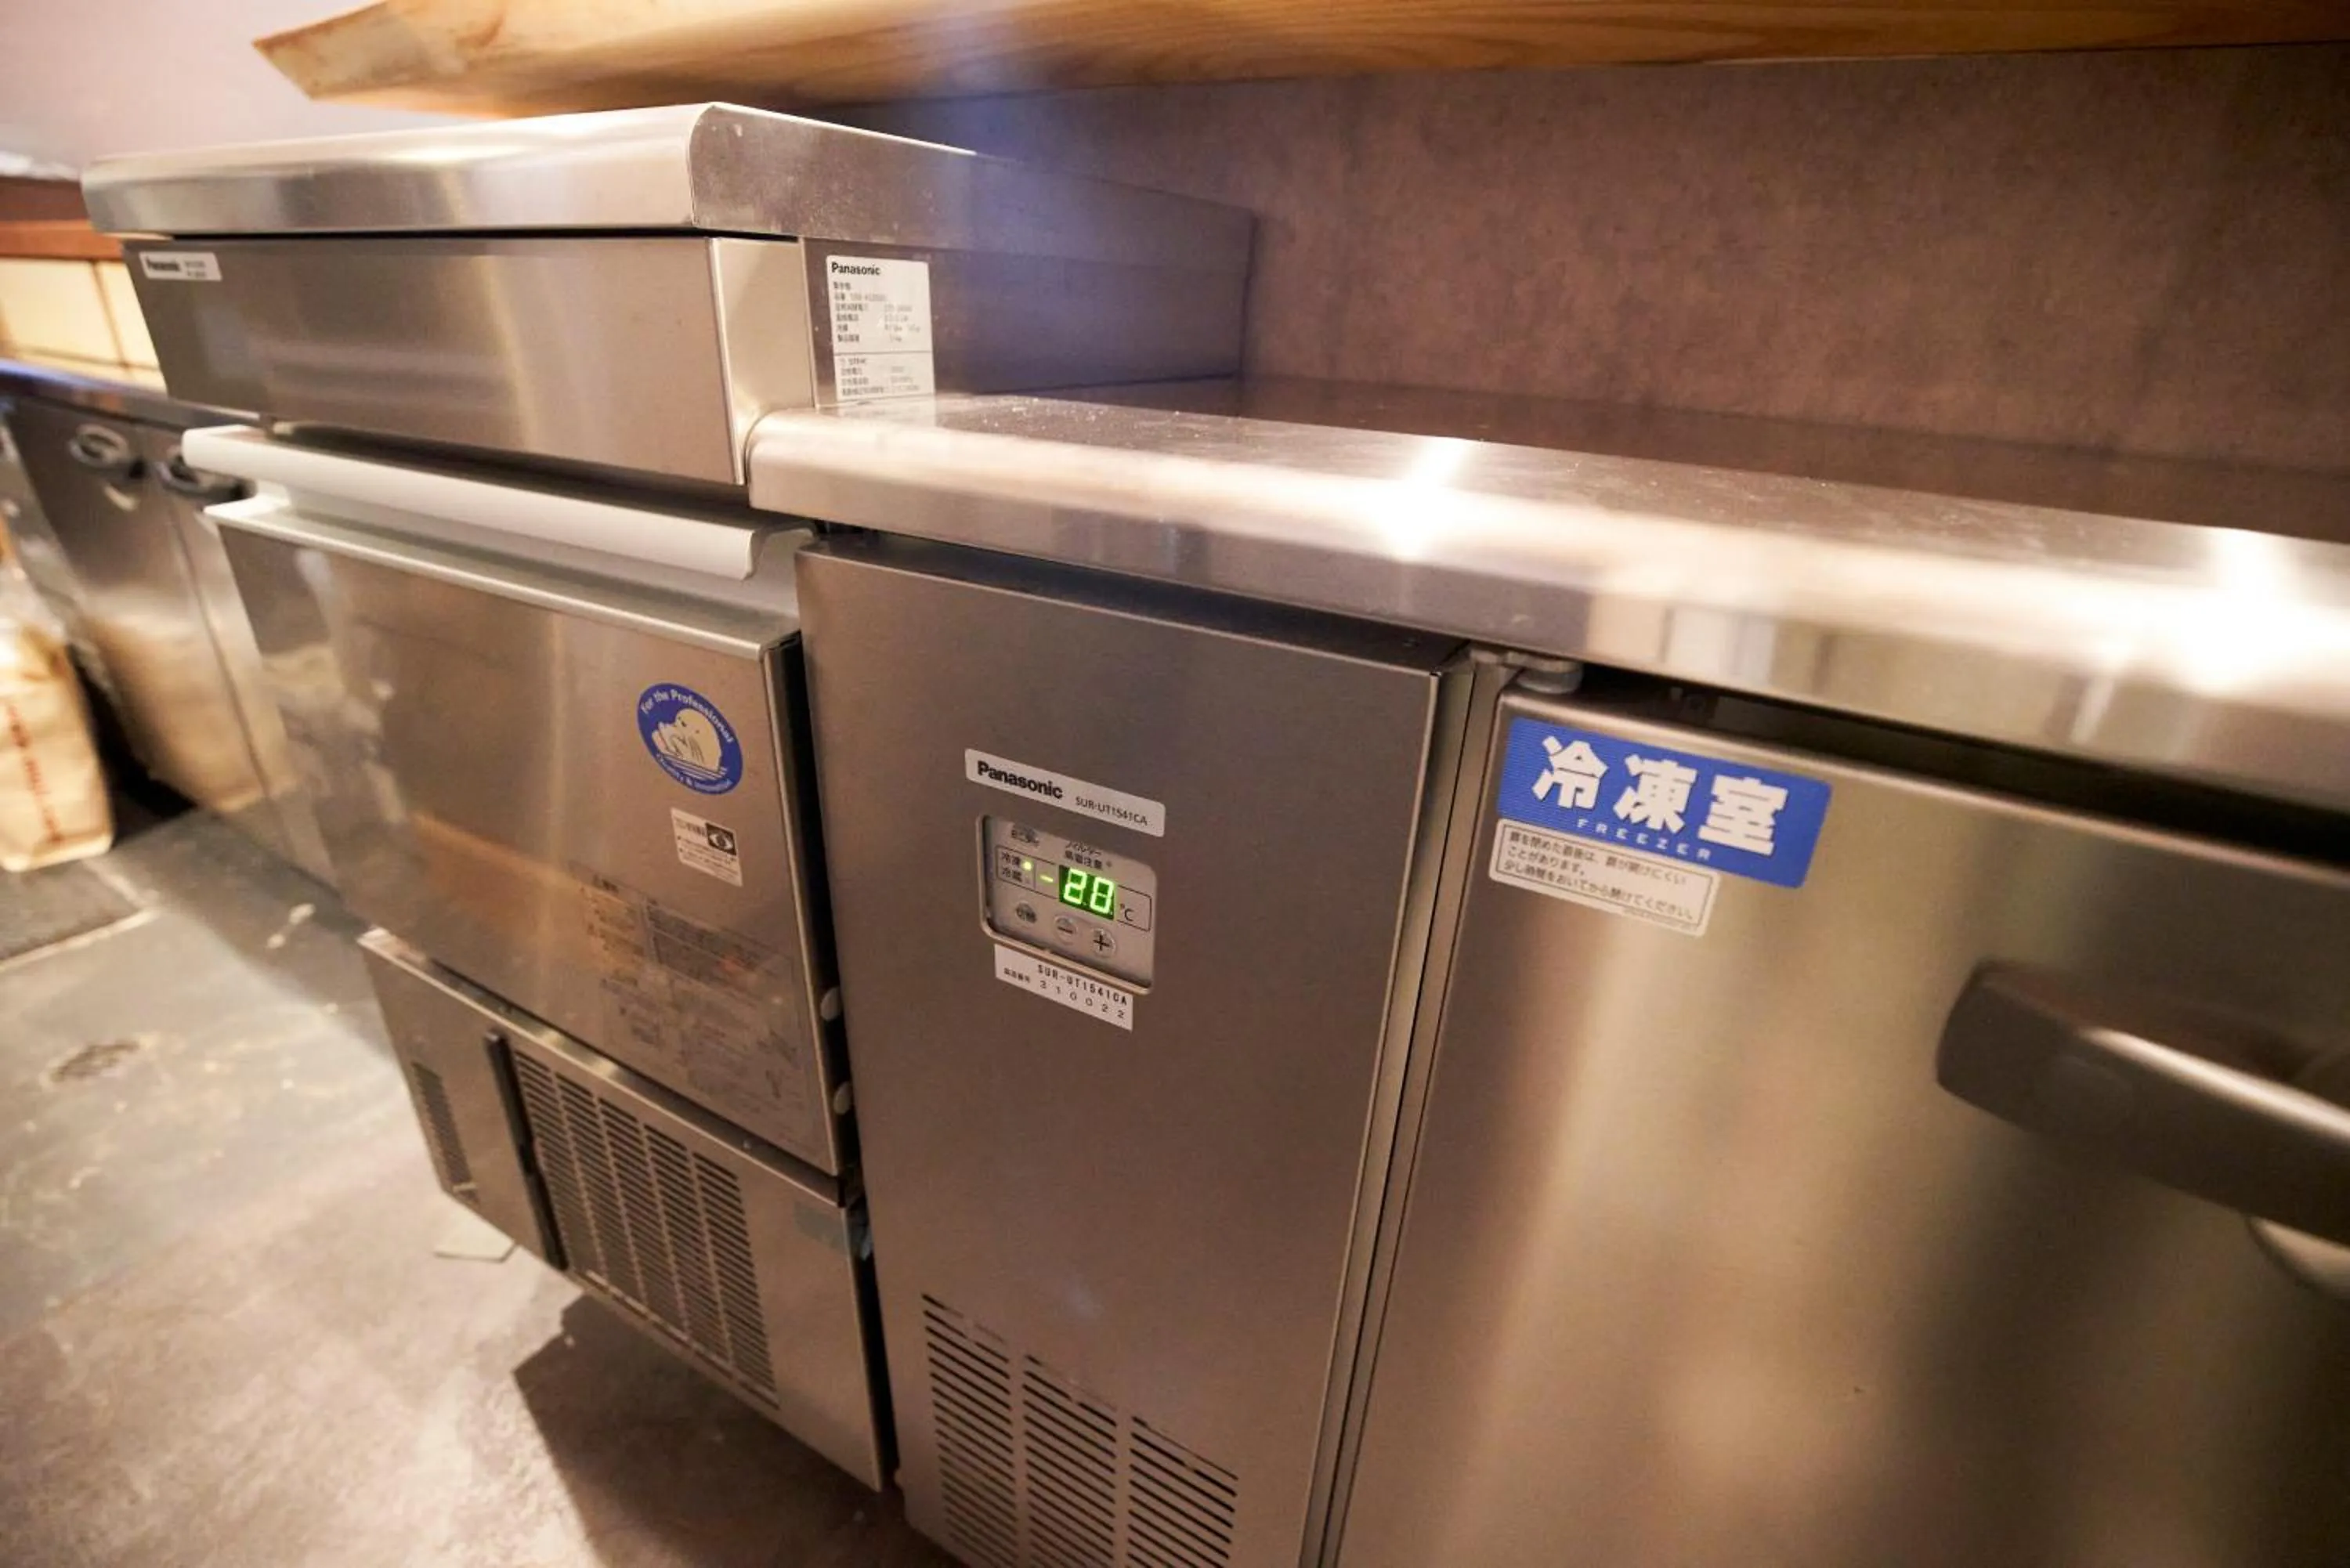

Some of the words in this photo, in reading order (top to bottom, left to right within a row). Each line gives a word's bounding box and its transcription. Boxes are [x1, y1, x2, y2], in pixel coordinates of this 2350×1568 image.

[831, 262, 880, 275] Panasonic
[978, 761, 1063, 799] Panasonic
[1076, 796, 1148, 826] SUR-UT1541CA
[1532, 735, 1788, 856] 冷凍室
[1577, 818, 1712, 861] FREEZER
